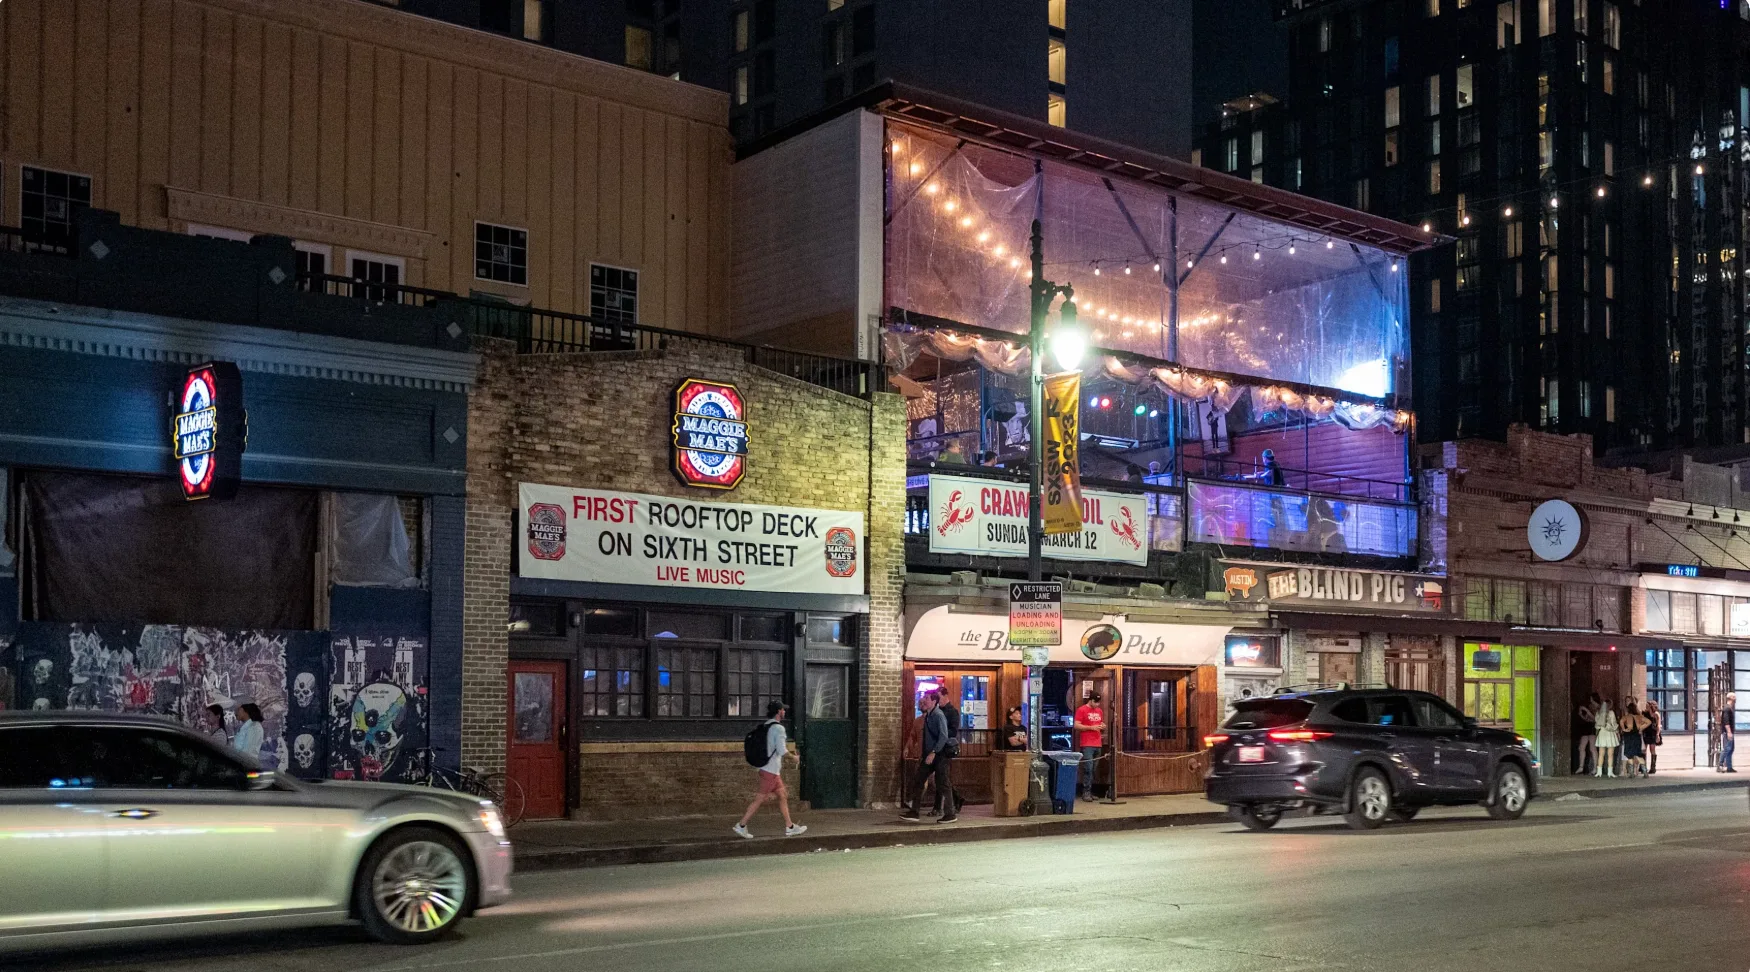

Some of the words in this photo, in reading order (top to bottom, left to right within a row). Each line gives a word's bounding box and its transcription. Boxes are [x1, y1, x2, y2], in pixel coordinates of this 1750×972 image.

[683, 416, 745, 438] MAGGIE
[689, 433, 738, 453] MAE'S
[1062, 414, 1076, 475] 2023
[1047, 440, 1061, 506] SXSW
[573, 495, 638, 524] FIRST
[648, 502, 753, 533] ROOFTOP
[762, 512, 819, 539] DECK
[1082, 497, 1104, 525] OIL
[531, 523, 564, 534] MAGGIE
[534, 532, 561, 541] MAE'S
[598, 530, 632, 557] ON
[643, 533, 707, 562] SIXTH
[717, 540, 798, 567] STREET
[827, 545, 854, 554] MAGGIE
[1085, 530, 1097, 550] 12
[830, 552, 851, 560] MAE'S
[657, 565, 690, 582] LIVE
[696, 568, 745, 585] MUSIC
[1230, 574, 1252, 585] AUSTIN
[1023, 585, 1061, 593] RESTRICTED
[1269, 572, 1297, 597] THE
[1298, 568, 1364, 601] BLIND
[1371, 573, 1405, 603] PIG
[1034, 592, 1050, 600] LANE
[960, 629, 982, 642] the
[1122, 634, 1165, 656] Pub
[347, 661, 362, 673] REST
